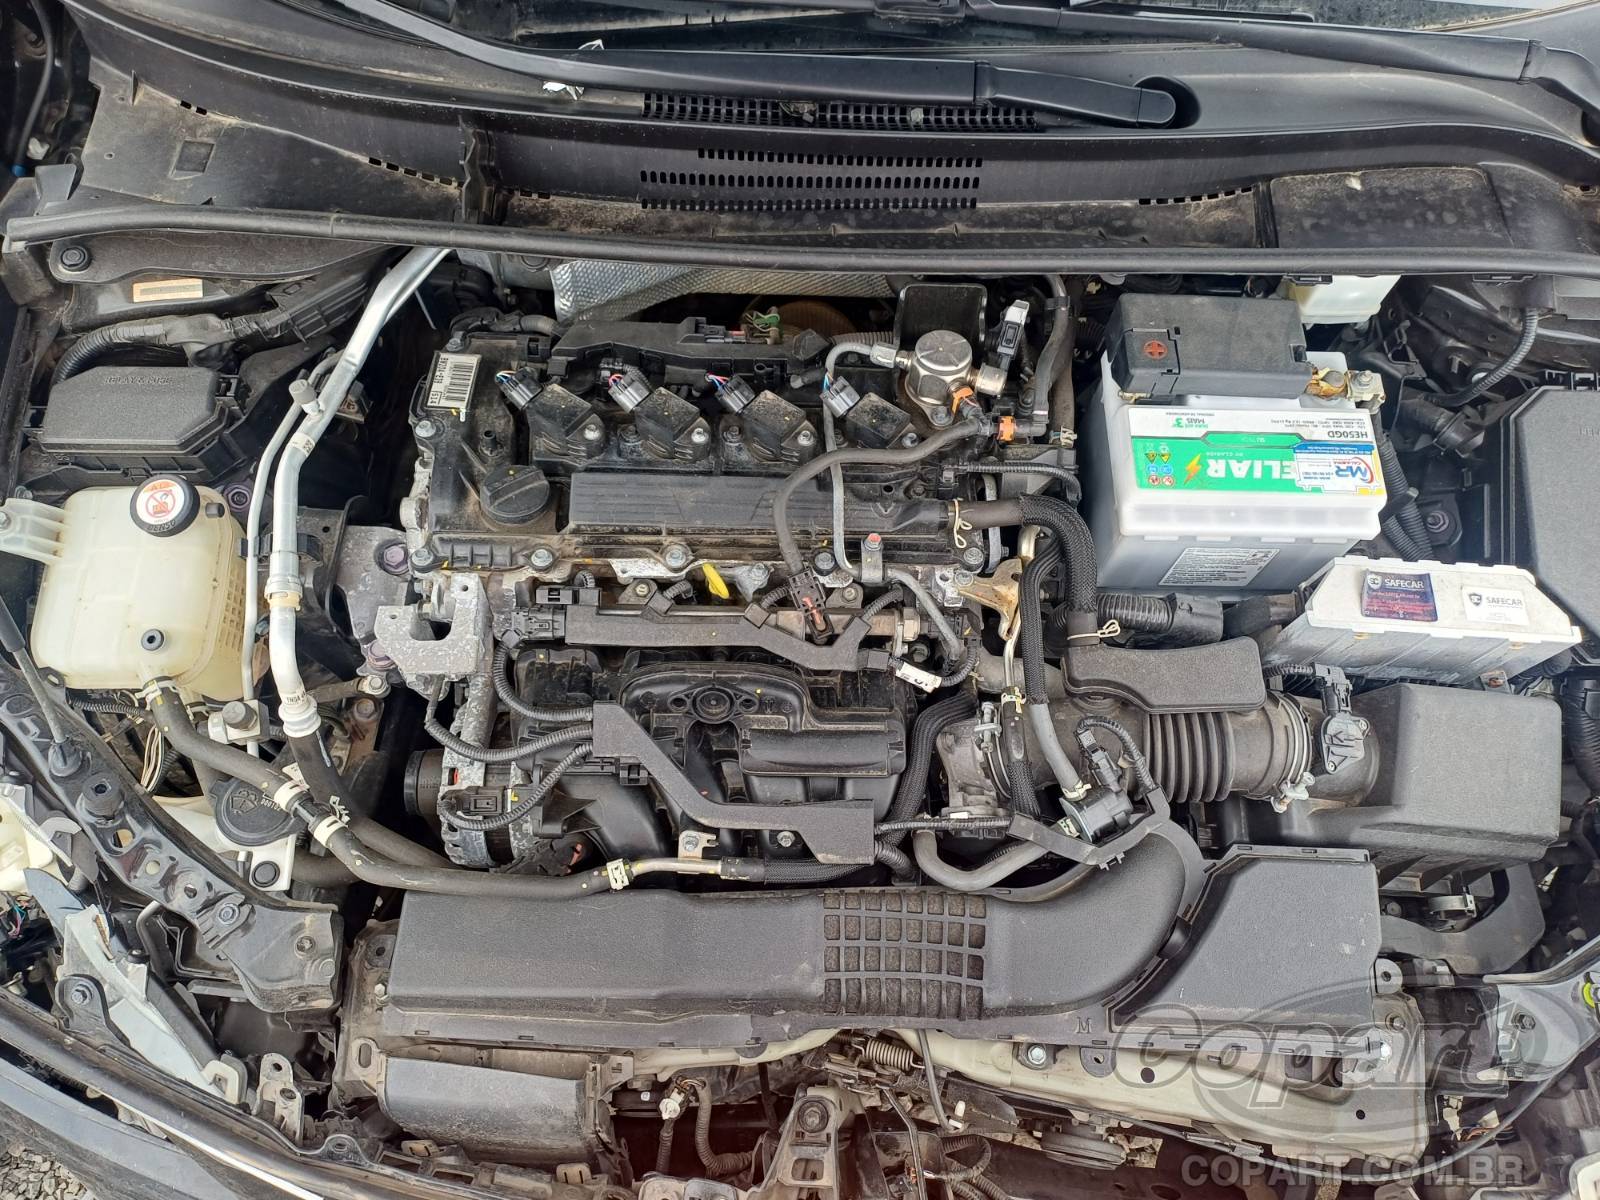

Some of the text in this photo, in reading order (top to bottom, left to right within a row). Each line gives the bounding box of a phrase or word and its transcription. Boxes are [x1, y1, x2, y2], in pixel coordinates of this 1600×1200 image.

[1327, 430, 1368, 439] HE50GD
[1335, 465, 1368, 478] MR
[147, 520, 176, 532] DENSO
[1384, 578, 1425, 589] SAFECAR
[1486, 596, 1523, 606] SAFECAR
[1076, 1016, 1092, 1034] M
